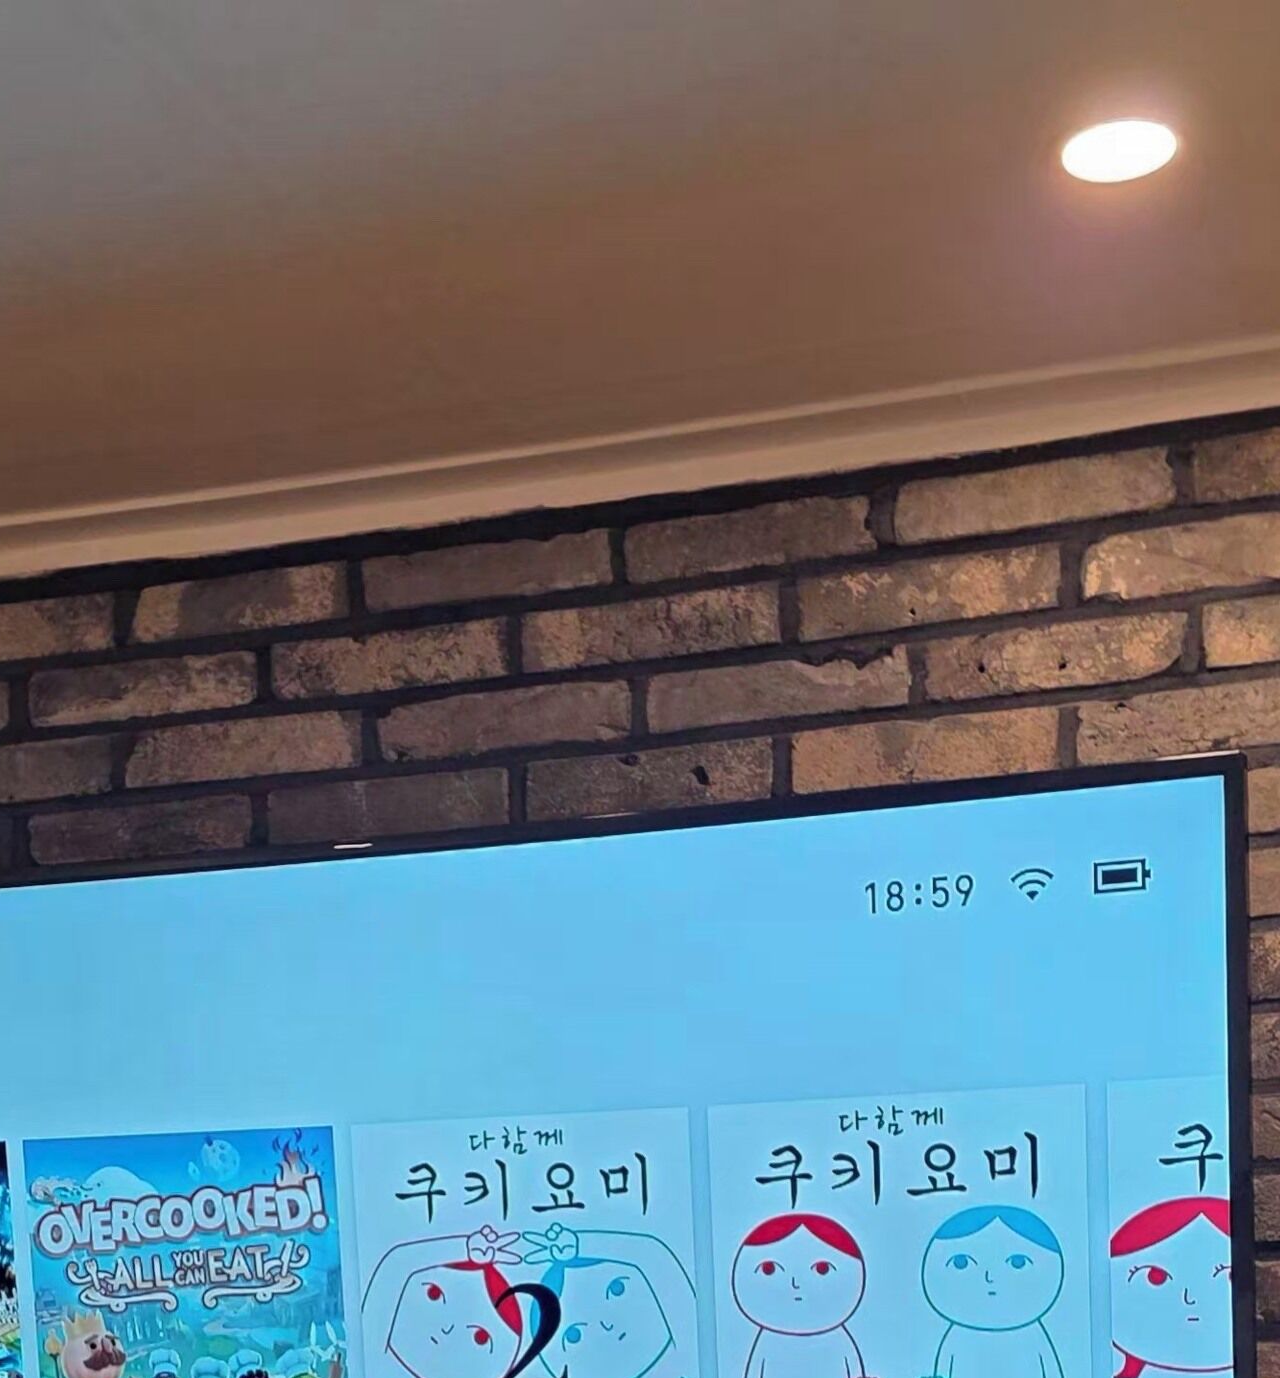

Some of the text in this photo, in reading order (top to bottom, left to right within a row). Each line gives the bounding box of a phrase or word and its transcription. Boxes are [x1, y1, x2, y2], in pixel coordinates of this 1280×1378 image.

[864, 874, 975, 914] 18:59
[839, 1105, 944, 1136] 다함께
[469, 1126, 563, 1155] 다함께
[395, 1152, 649, 1224] 쿠키요미
[755, 1131, 1039, 1210] 쿠키요미
[36, 1176, 330, 1257] OVERCOOKED!
[111, 1254, 170, 1291] ALL
[173, 1249, 205, 1267] YOU
[174, 1267, 207, 1286] CAN
[206, 1244, 270, 1284] EAT
